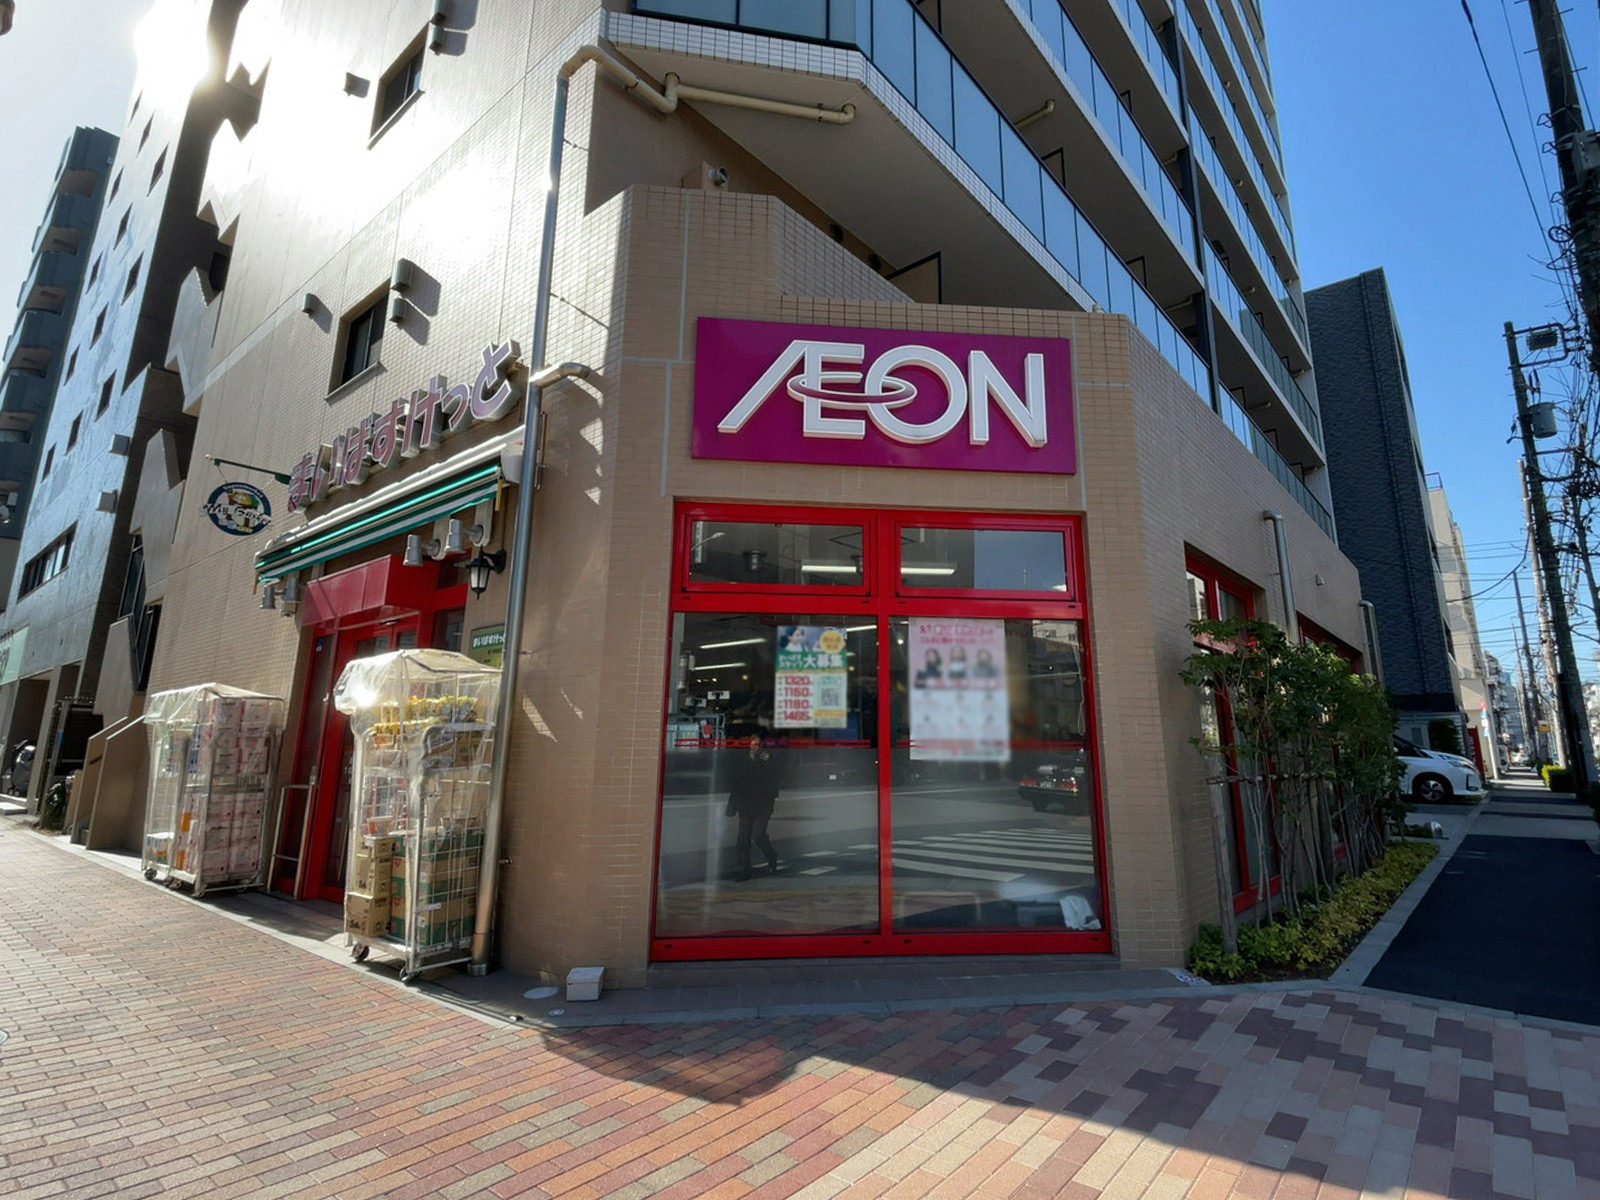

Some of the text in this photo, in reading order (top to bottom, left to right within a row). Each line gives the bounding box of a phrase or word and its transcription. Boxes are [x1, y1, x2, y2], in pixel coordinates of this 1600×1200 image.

[288, 338, 522, 514] まいばすけっと
